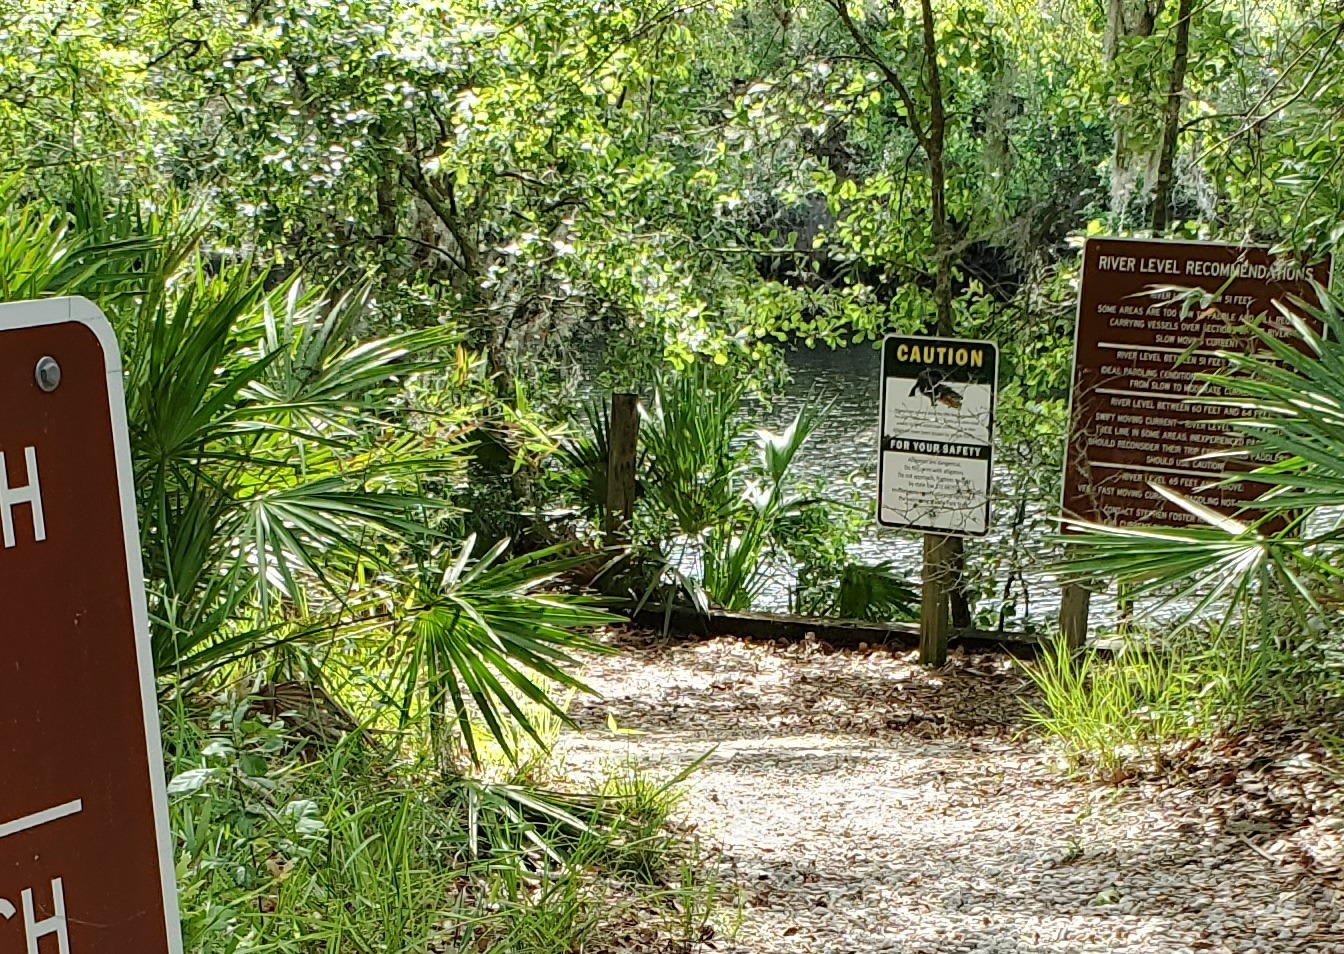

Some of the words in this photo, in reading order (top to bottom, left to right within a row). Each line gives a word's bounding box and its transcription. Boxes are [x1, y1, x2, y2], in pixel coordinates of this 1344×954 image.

[1098, 255, 1136, 273] RIVER
[1139, 257, 1181, 274] LEVEL
[1097, 304, 1117, 314] SOME
[1119, 306, 1144, 316] AREAS
[1163, 308, 1177, 318] TOO
[1147, 320, 1179, 331] VESSELS
[1181, 322, 1201, 332] OVER
[1156, 334, 1175, 343] SLOW
[896, 343, 984, 368] CAUTION
[1117, 351, 1138, 360] RIVER
[1139, 352, 1162, 362] LEVEL
[1151, 381, 1171, 390] SLOW
[1173, 383, 1182, 392] TO
[1110, 397, 1131, 407] RIVER
[1132, 399, 1155, 409] LEVEL
[1157, 401, 1190, 412] BETWEEN
[1203, 406, 1221, 415] FEET
[1223, 408, 1240, 416] AND
[1117, 415, 1144, 425] MOVING
[1114, 427, 1130, 436] LINE
[1131, 428, 1140, 437] IN
[1140, 429, 1161, 439] SOME
[890, 439, 910, 450] FOR
[913, 441, 940, 453] YOUR
[942, 444, 982, 457] SAFETY
[1087, 437, 1116, 448] SHOULD
[1117, 440, 1160, 452] RECONSIDER
[1162, 443, 1182, 454] THEIR
[1146, 455, 1175, 466] SHOULD
[1121, 472, 1142, 482] RIVER
[1179, 478, 1197, 487] FEET
[1116, 488, 1143, 499] MOVING
